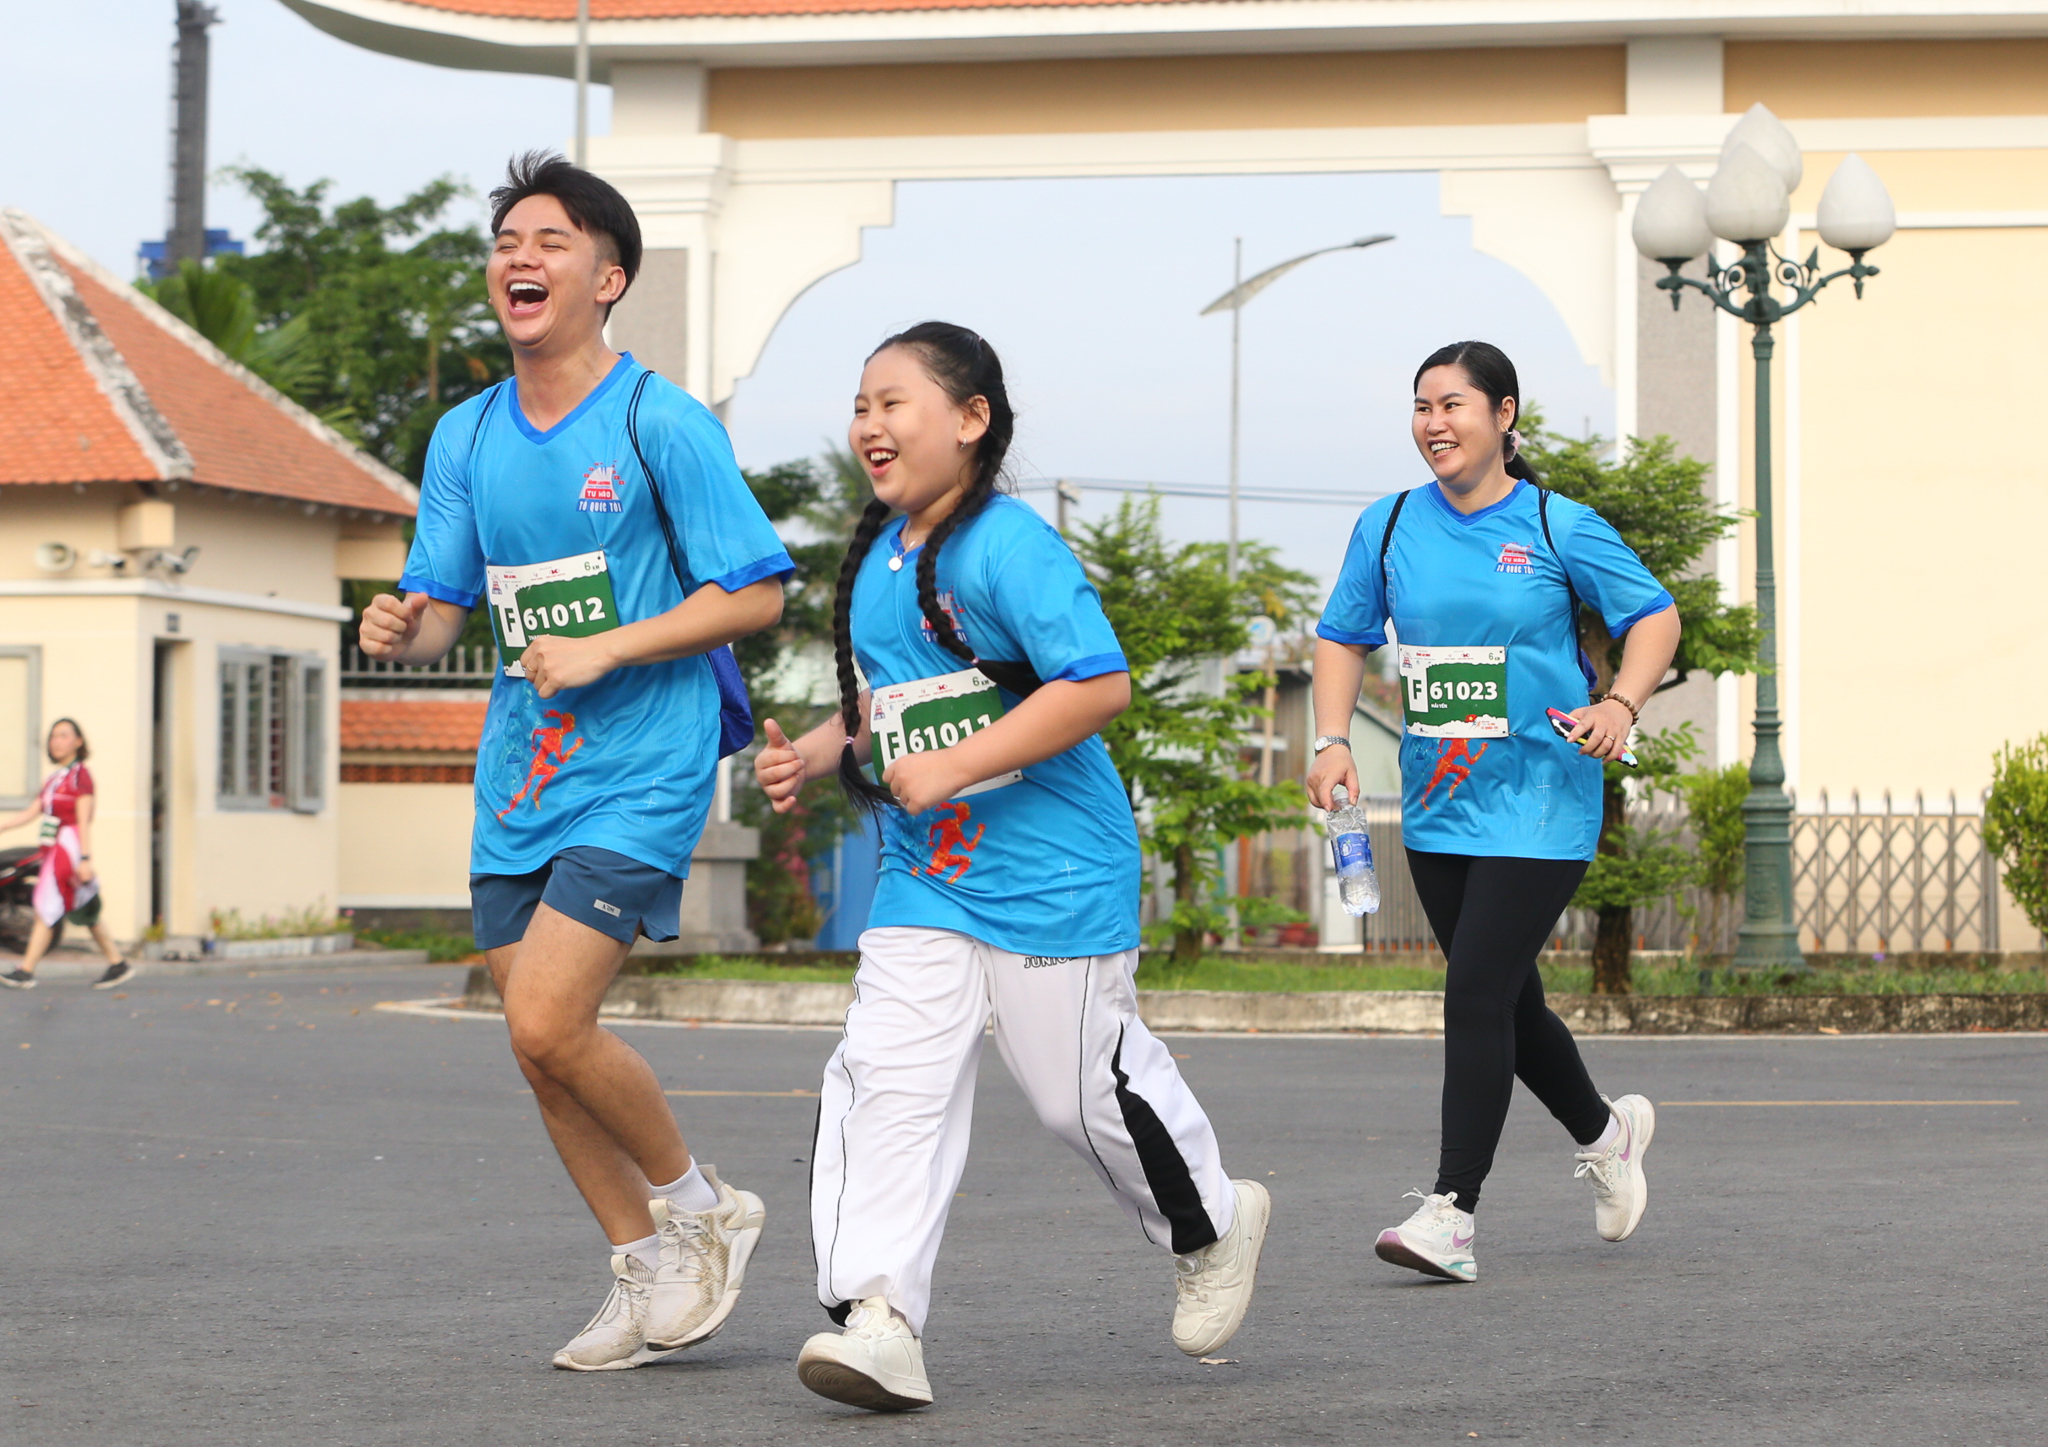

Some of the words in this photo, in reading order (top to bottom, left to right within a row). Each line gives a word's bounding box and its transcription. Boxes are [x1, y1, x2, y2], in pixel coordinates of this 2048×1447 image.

[584, 562, 591, 571] 6
[504, 608, 516, 633] F
[523, 597, 606, 631] 61012
[972, 677, 980, 686] 6
[1413, 679, 1422, 700] F
[1430, 681, 1498, 700] 61023
[887, 731, 900, 760] F
